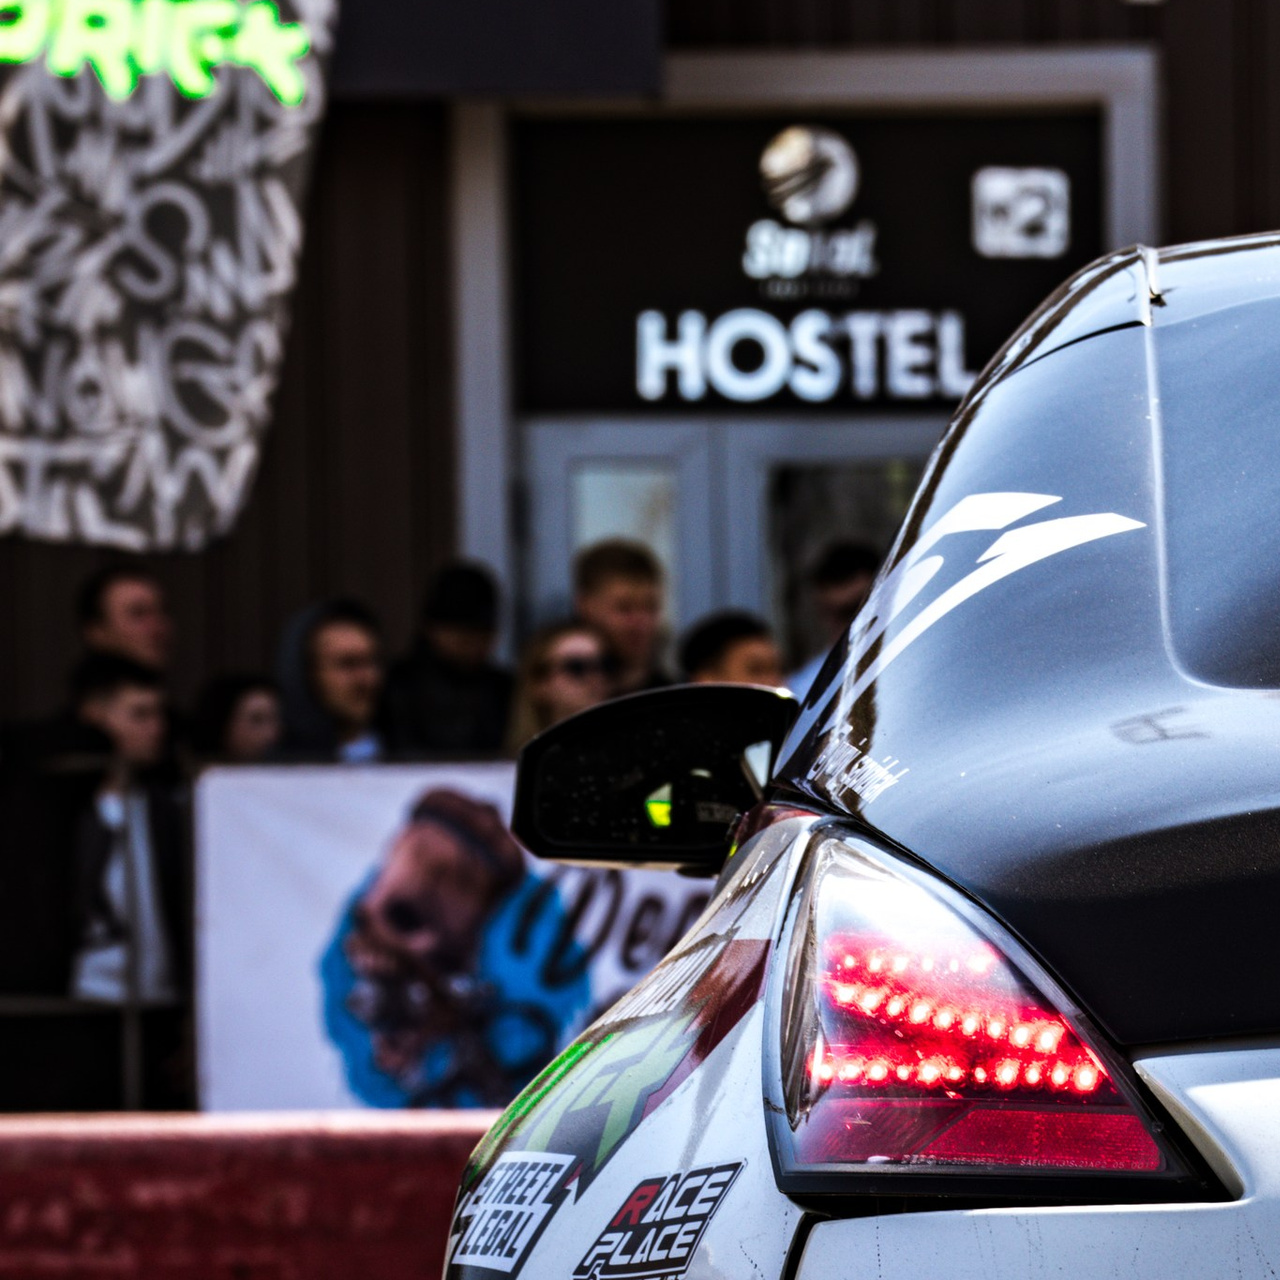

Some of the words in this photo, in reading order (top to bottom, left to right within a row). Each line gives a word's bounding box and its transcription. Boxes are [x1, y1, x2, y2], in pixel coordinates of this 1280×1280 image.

[635, 307, 981, 403] HOSTEL
[474, 1161, 565, 1206] STREET
[611, 1169, 735, 1227] RACE
[459, 1208, 535, 1259] LEGAL
[582, 1220, 704, 1267] PLACE
